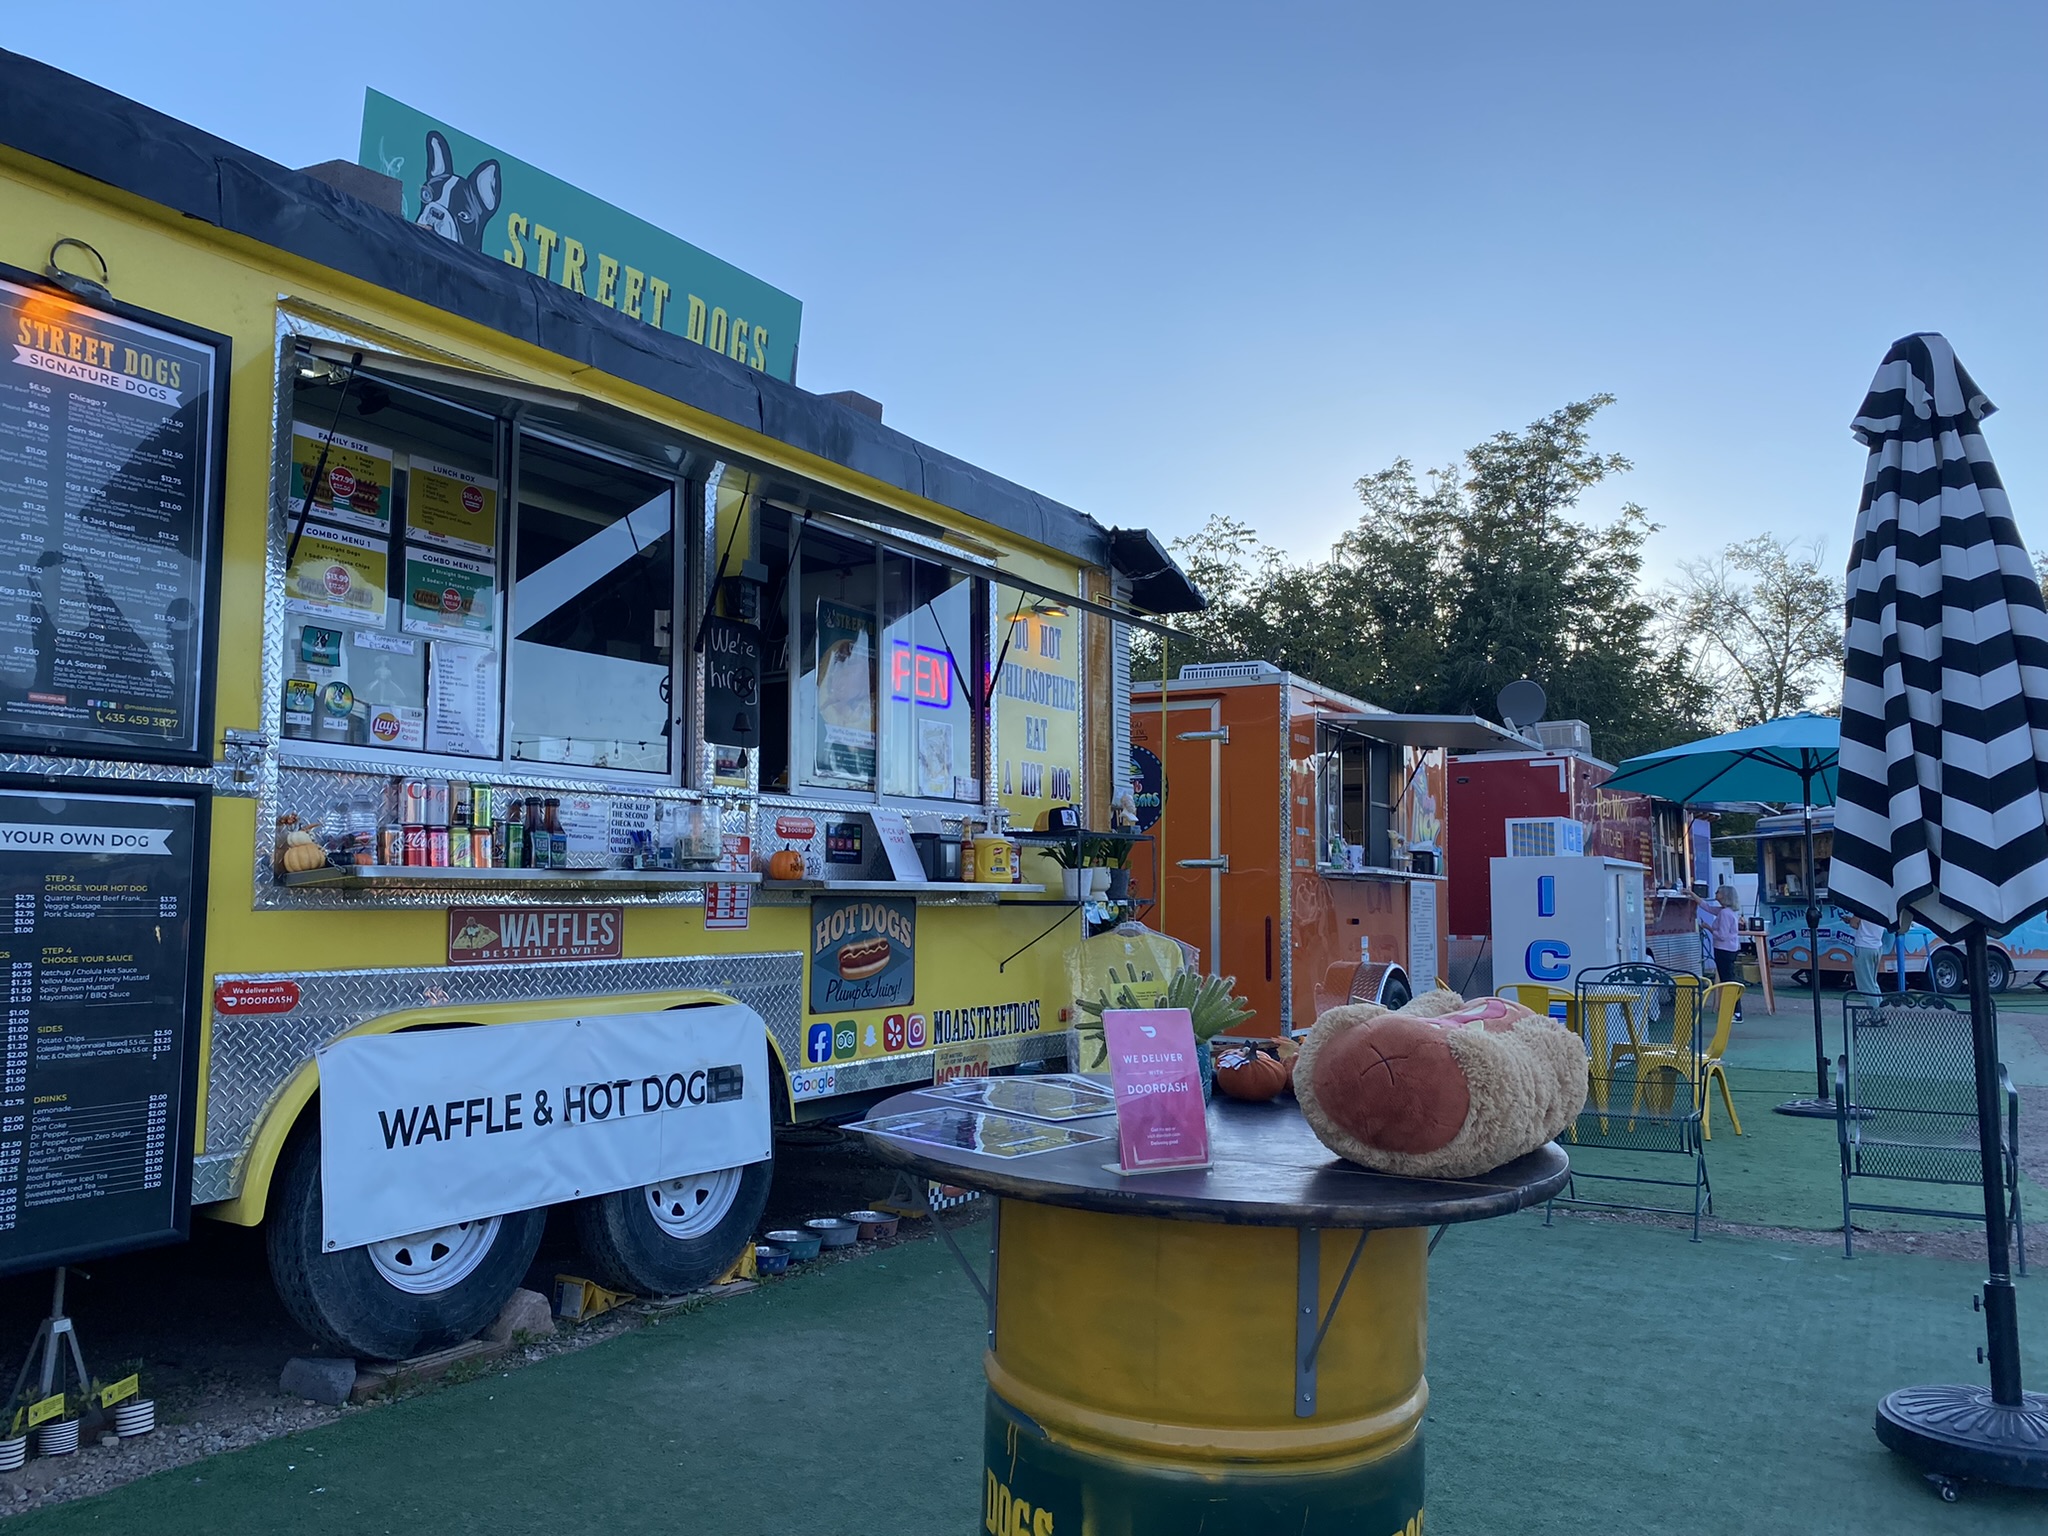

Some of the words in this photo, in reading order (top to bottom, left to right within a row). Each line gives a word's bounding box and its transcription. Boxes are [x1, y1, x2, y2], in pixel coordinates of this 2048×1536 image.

[503, 212, 671, 329] STREET
[683, 293, 769, 372] DOGS
[18, 316, 114, 369] STREET
[123, 348, 182, 388] DOGS
[29, 354, 119, 387] SIGNATURE
[125, 376, 167, 400] DOGS
[69, 393, 100, 406] Chicago
[162, 417, 184, 428] $12.50
[68, 425, 87, 435] Corn
[88, 429, 104, 438] Star
[162, 448, 184, 460] $12.50
[351, 442, 369, 453] SIZE
[66, 452, 103, 466] Hangover
[106, 461, 121, 471] Dog
[433, 466, 458, 478] LUNCH
[460, 474, 476, 483] BOX
[66, 482, 81, 492] Egg
[90, 487, 107, 497] Dog
[160, 500, 182, 511] $13.00
[64, 512, 80, 521] Mac
[90, 517, 107, 527] Jack
[109, 521, 136, 532] Russell
[306, 527, 339, 540] COMBO
[342, 535, 365, 546] MENU
[63, 543, 88, 553] Cuban
[90, 548, 105, 558] Dog
[108, 550, 141, 564] (Toasted)
[157, 560, 178, 570] $13.50
[423, 554, 450, 565] COMBO
[453, 562, 474, 571] MENU
[61, 567, 86, 577] Vegan
[88, 571, 104, 581] Dog
[156, 583, 177, 592] $13.50
[59, 598, 86, 608] Desert
[87, 602, 116, 613] Vegans
[89, 632, 105, 642] Dog
[1014, 618, 1029, 649] DO
[1039, 624, 1062, 661] NOT
[54, 658, 65, 666] As
[75, 660, 107, 670] Sonoran
[711, 661, 758, 706] hirig
[999, 667, 1076, 711] PHILOSOPHIZE
[105, 712, 126, 723] 435
[128, 715, 149, 725] 459
[152, 717, 178, 728] 3827
[374, 717, 399, 736] Lay's
[1025, 716, 1048, 752] EAT
[1003, 762, 1013, 795] A
[1021, 764, 1044, 798] HOT
[1051, 766, 1071, 801] DOG
[612, 802, 634, 810] PLEASE
[635, 803, 651, 811] KEEP
[625, 811, 649, 819] SECOND
[2, 830, 54, 845] YOUR
[60, 833, 105, 846] OWN
[111, 834, 150, 848] DOG
[1563, 823, 1582, 852] ICE
[44, 884, 82, 892] CHOOSE
[44, 903, 69, 911] Veggie
[71, 903, 101, 911] Sausage
[63, 911, 95, 919] Sausage
[500, 912, 615, 948] WAFFLES
[816, 903, 859, 954] HOT
[861, 902, 912, 949] DOGS
[41, 956, 78, 964] CHOOSE
[80, 955, 104, 963] YOUR
[482, 949, 521, 959] BEST
[527, 949, 542, 957] IN
[551, 946, 597, 956] TOWN!
[826, 979, 860, 1008] Plump
[872, 976, 903, 1002] Juicy!
[240, 996, 293, 1005] DOORDASH
[37, 1025, 63, 1034] SIDES
[933, 999, 1040, 1045] MOABSTREETDOGS
[64, 1035, 86, 1043] Chips
[1123, 1054, 1139, 1064] WE
[1141, 1052, 1183, 1063] DELIVER
[937, 1066, 961, 1085] HOT
[792, 1073, 835, 1094] Google
[1127, 1082, 1189, 1095] DOORDASH
[34, 1094, 68, 1104] DRINKS
[378, 1094, 522, 1150] WAFFLE
[534, 1090, 554, 1126] &
[563, 1080, 631, 1123] HOT
[642, 1070, 706, 1113] DOG
